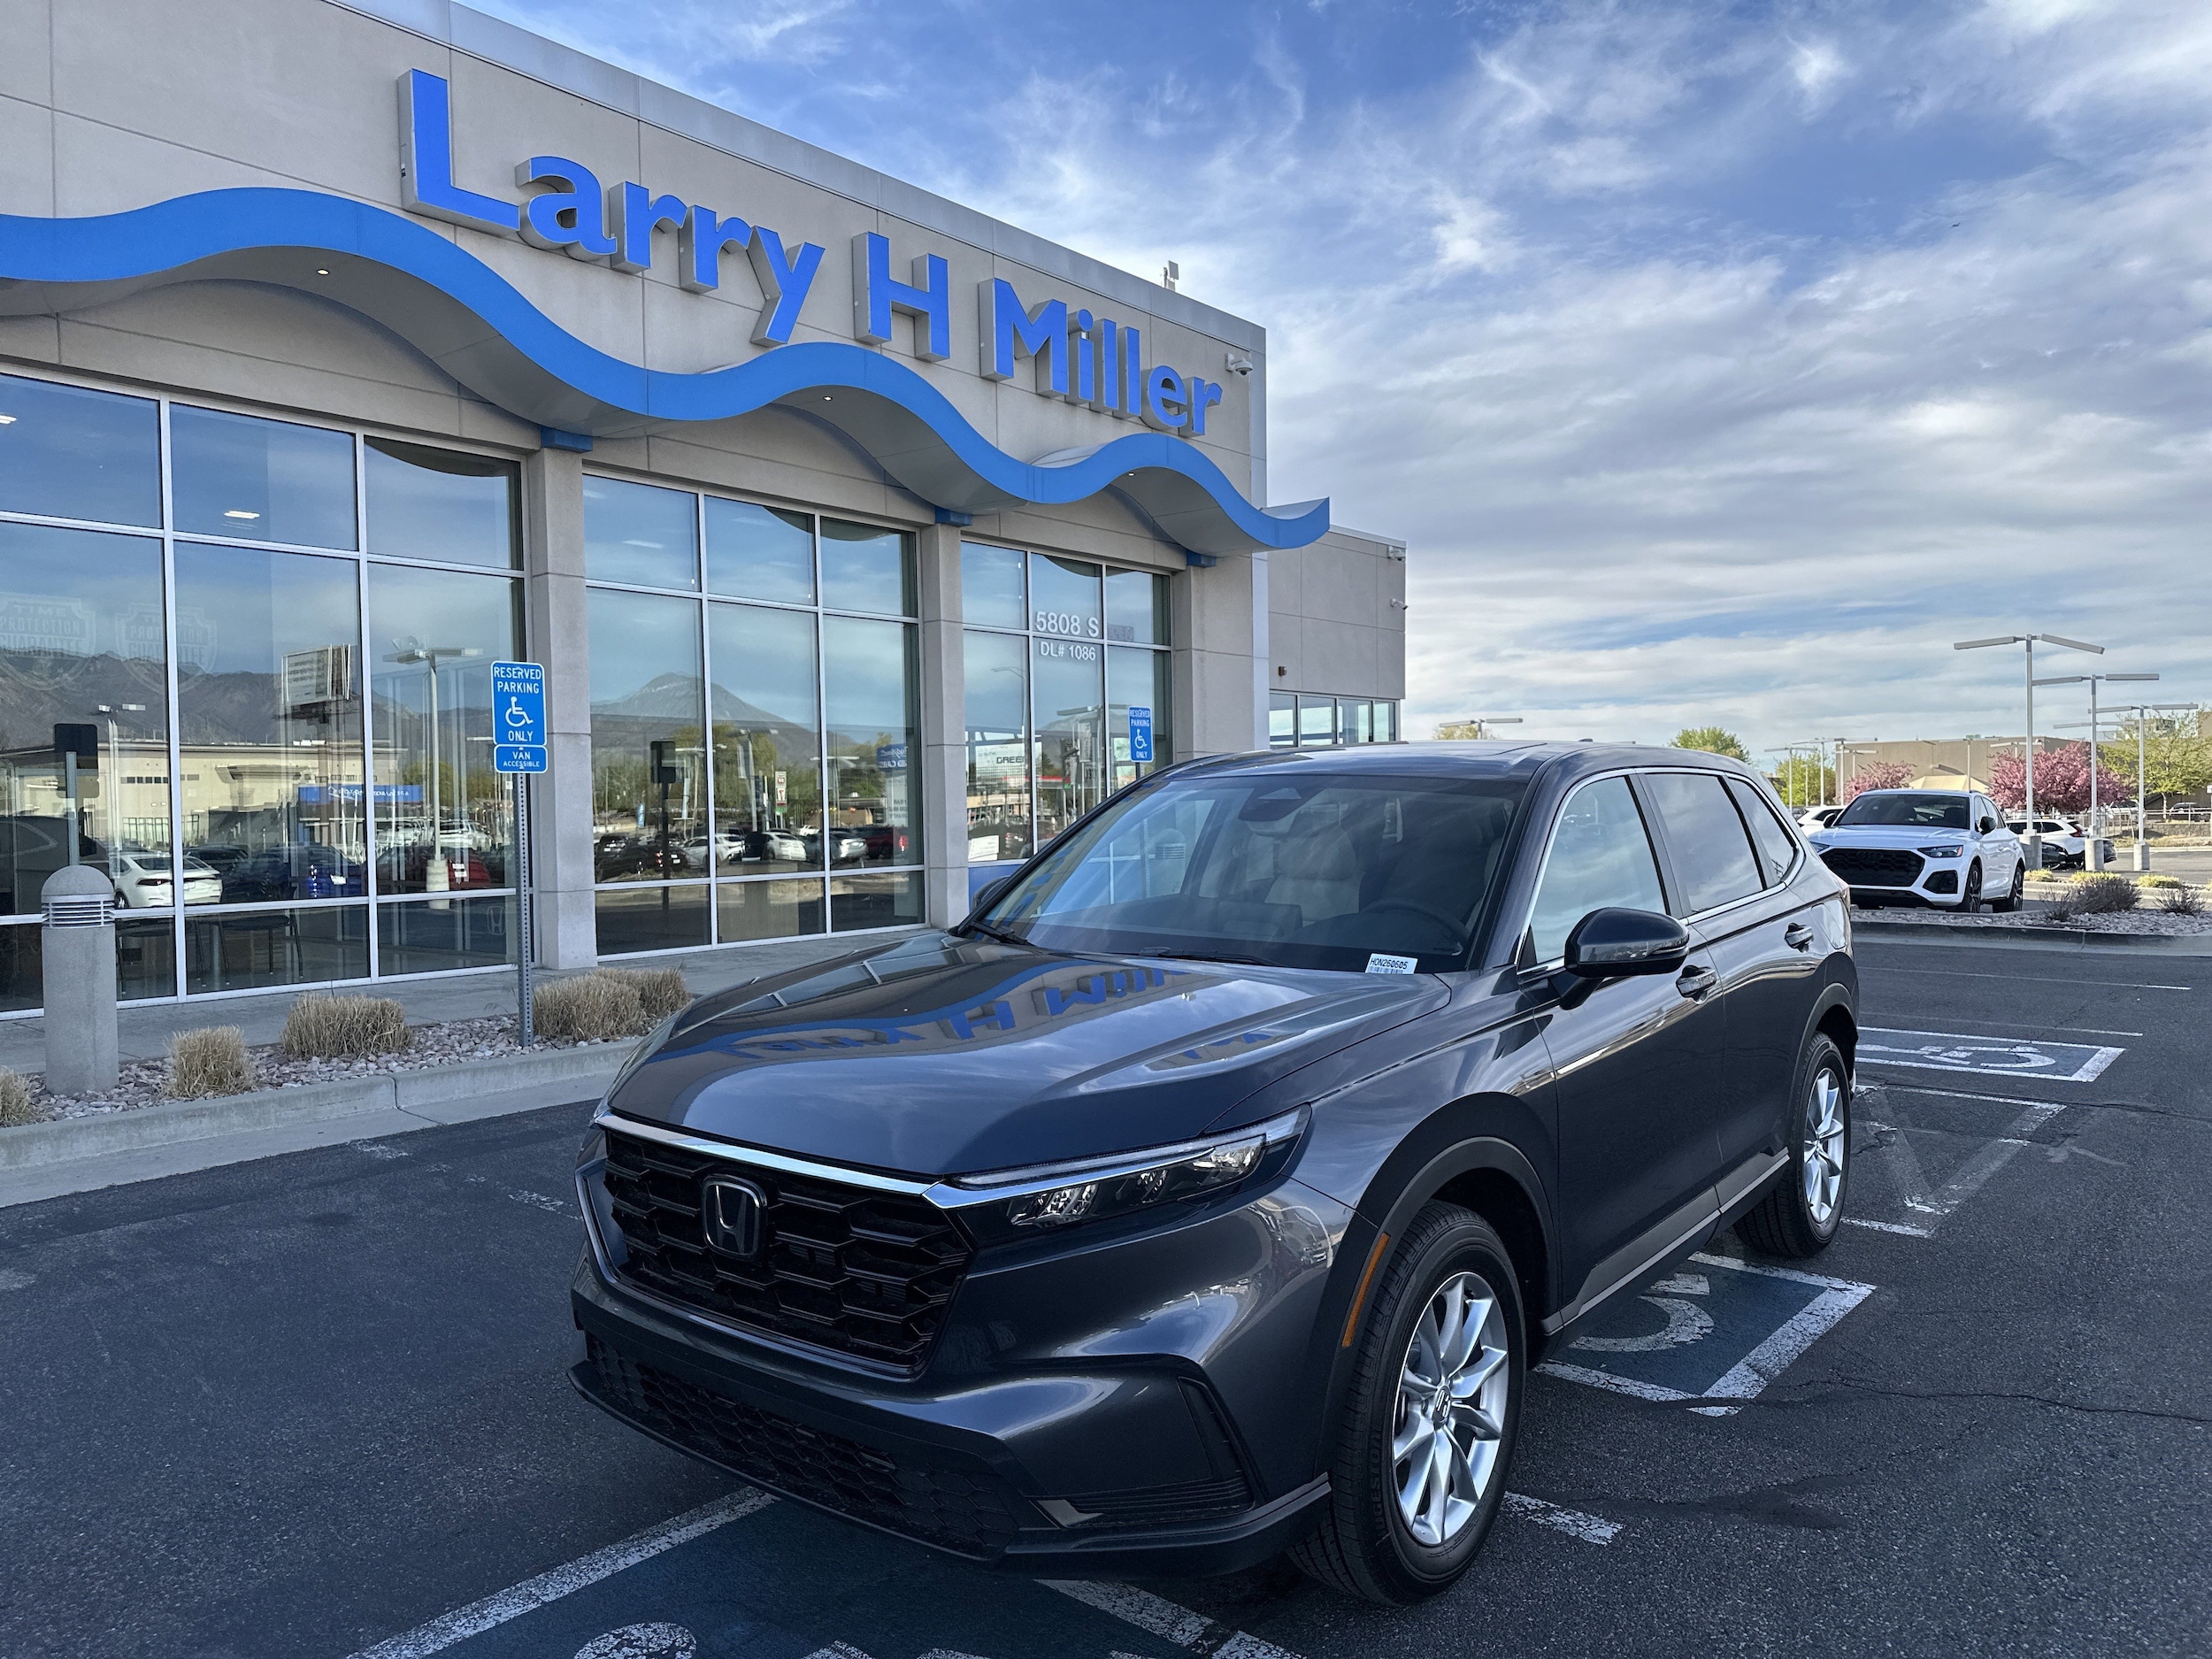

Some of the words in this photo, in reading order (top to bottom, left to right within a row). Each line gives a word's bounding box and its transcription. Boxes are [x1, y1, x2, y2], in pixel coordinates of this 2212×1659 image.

[403, 68, 826, 346] Larry
[858, 231, 950, 361] H
[983, 277, 1224, 437] Miller
[1036, 611, 1081, 635] 5808
[1087, 617, 1099, 637] S
[1041, 641, 1064, 657] DL#
[1068, 645, 1096, 661] 1086
[494, 666, 541, 680] RESERVED
[497, 681, 540, 694] PARKING
[508, 730, 534, 741] ONLY
[512, 751, 531, 760] VAN
